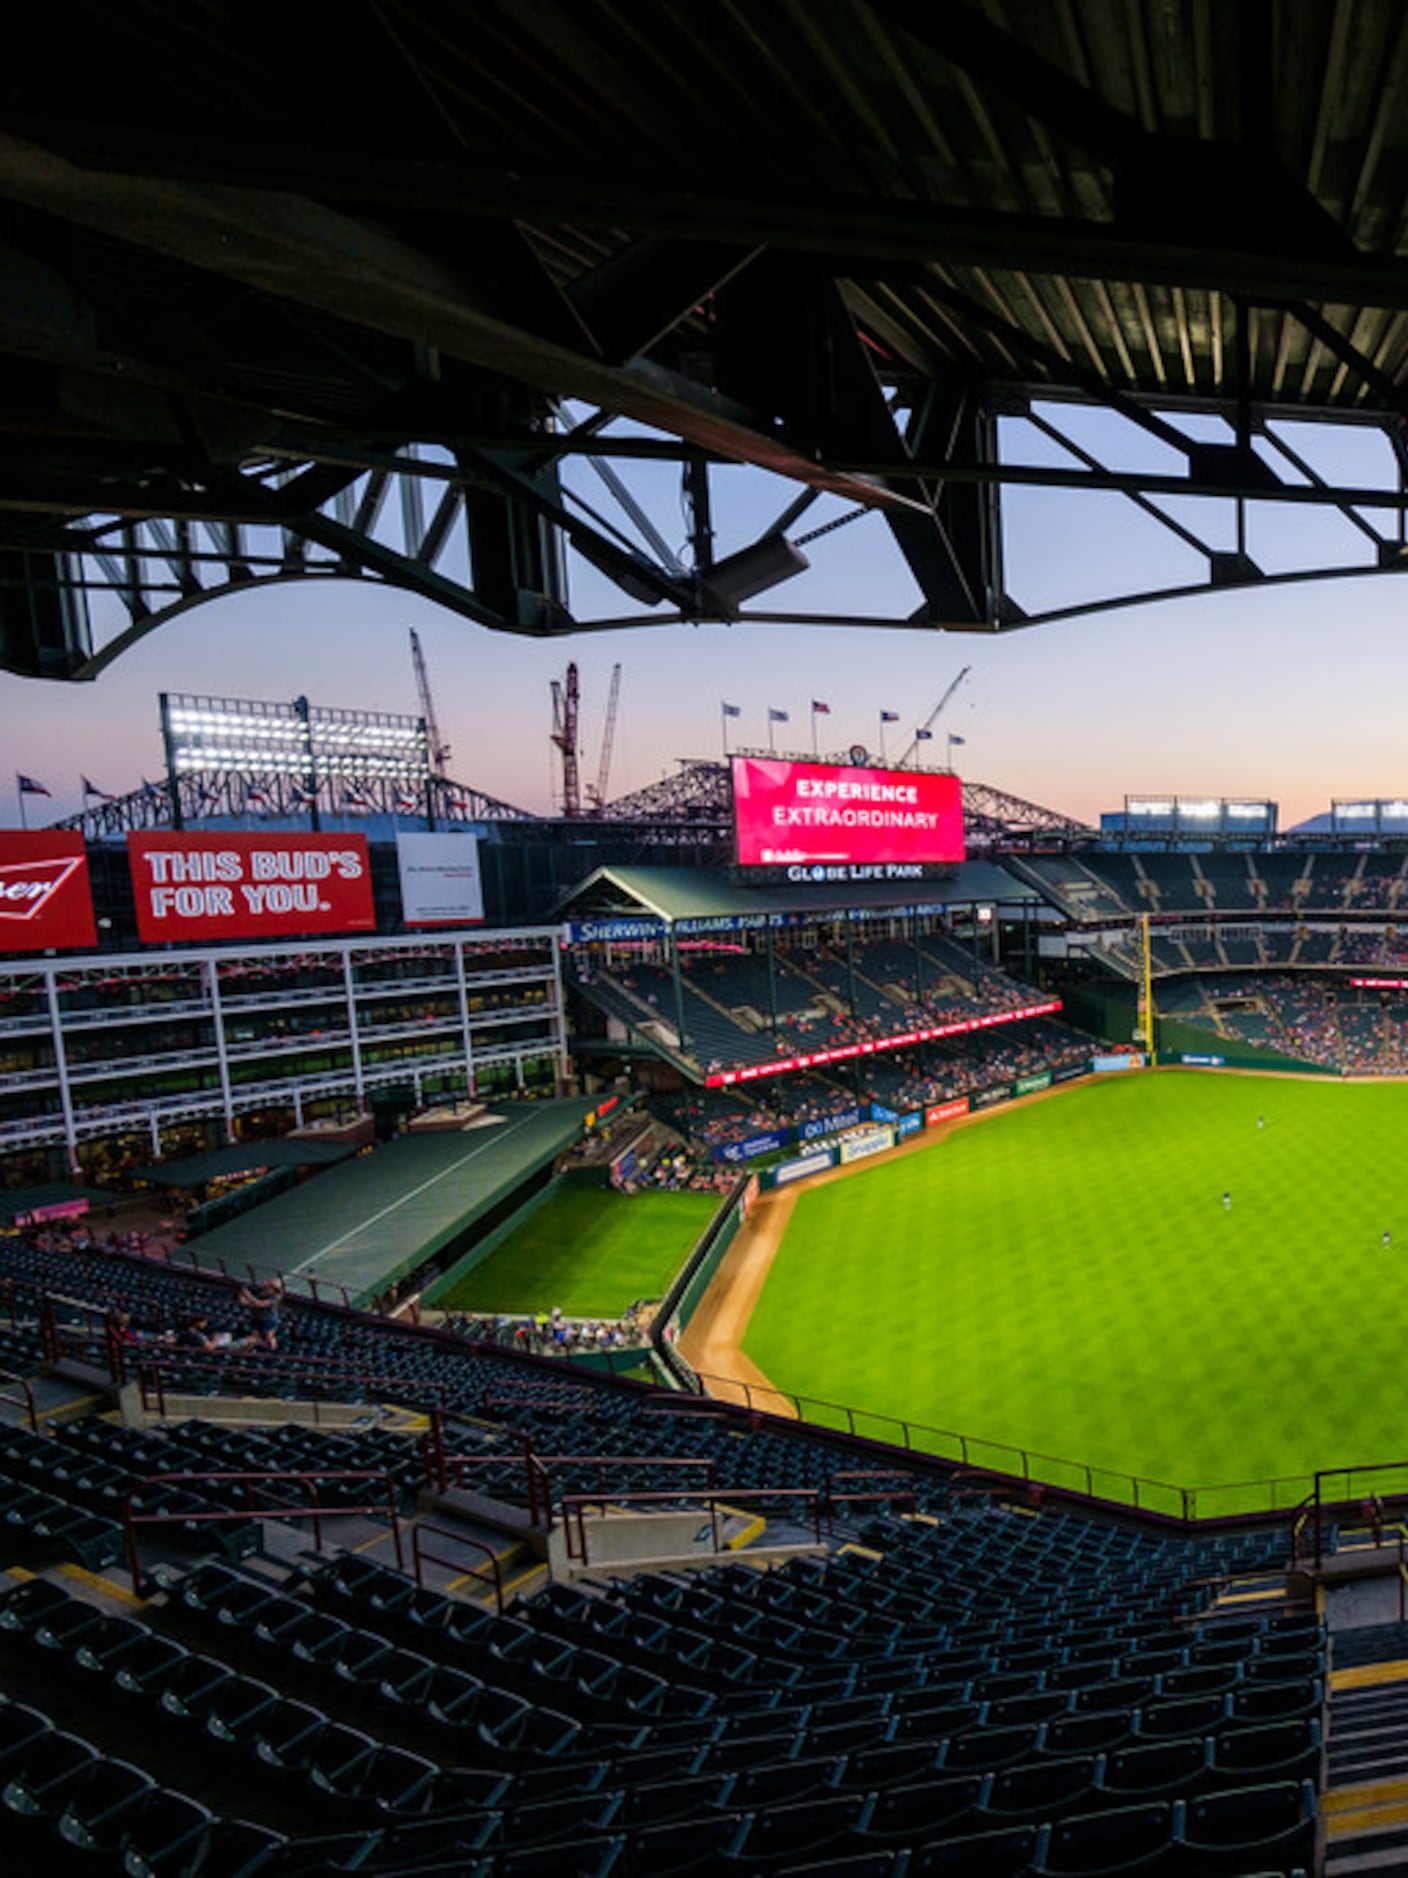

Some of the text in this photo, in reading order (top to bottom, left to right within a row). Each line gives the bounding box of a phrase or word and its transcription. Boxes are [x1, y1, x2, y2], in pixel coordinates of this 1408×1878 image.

[796, 779, 918, 803] EXPERIENCE
[773, 806, 939, 829] EXTRAORDINARY
[142, 850, 363, 883] THIS BUD'S
[849, 864, 884, 879] LIFE
[886, 863, 923, 878] PARK
[150, 883, 332, 918] FOR YOU.
